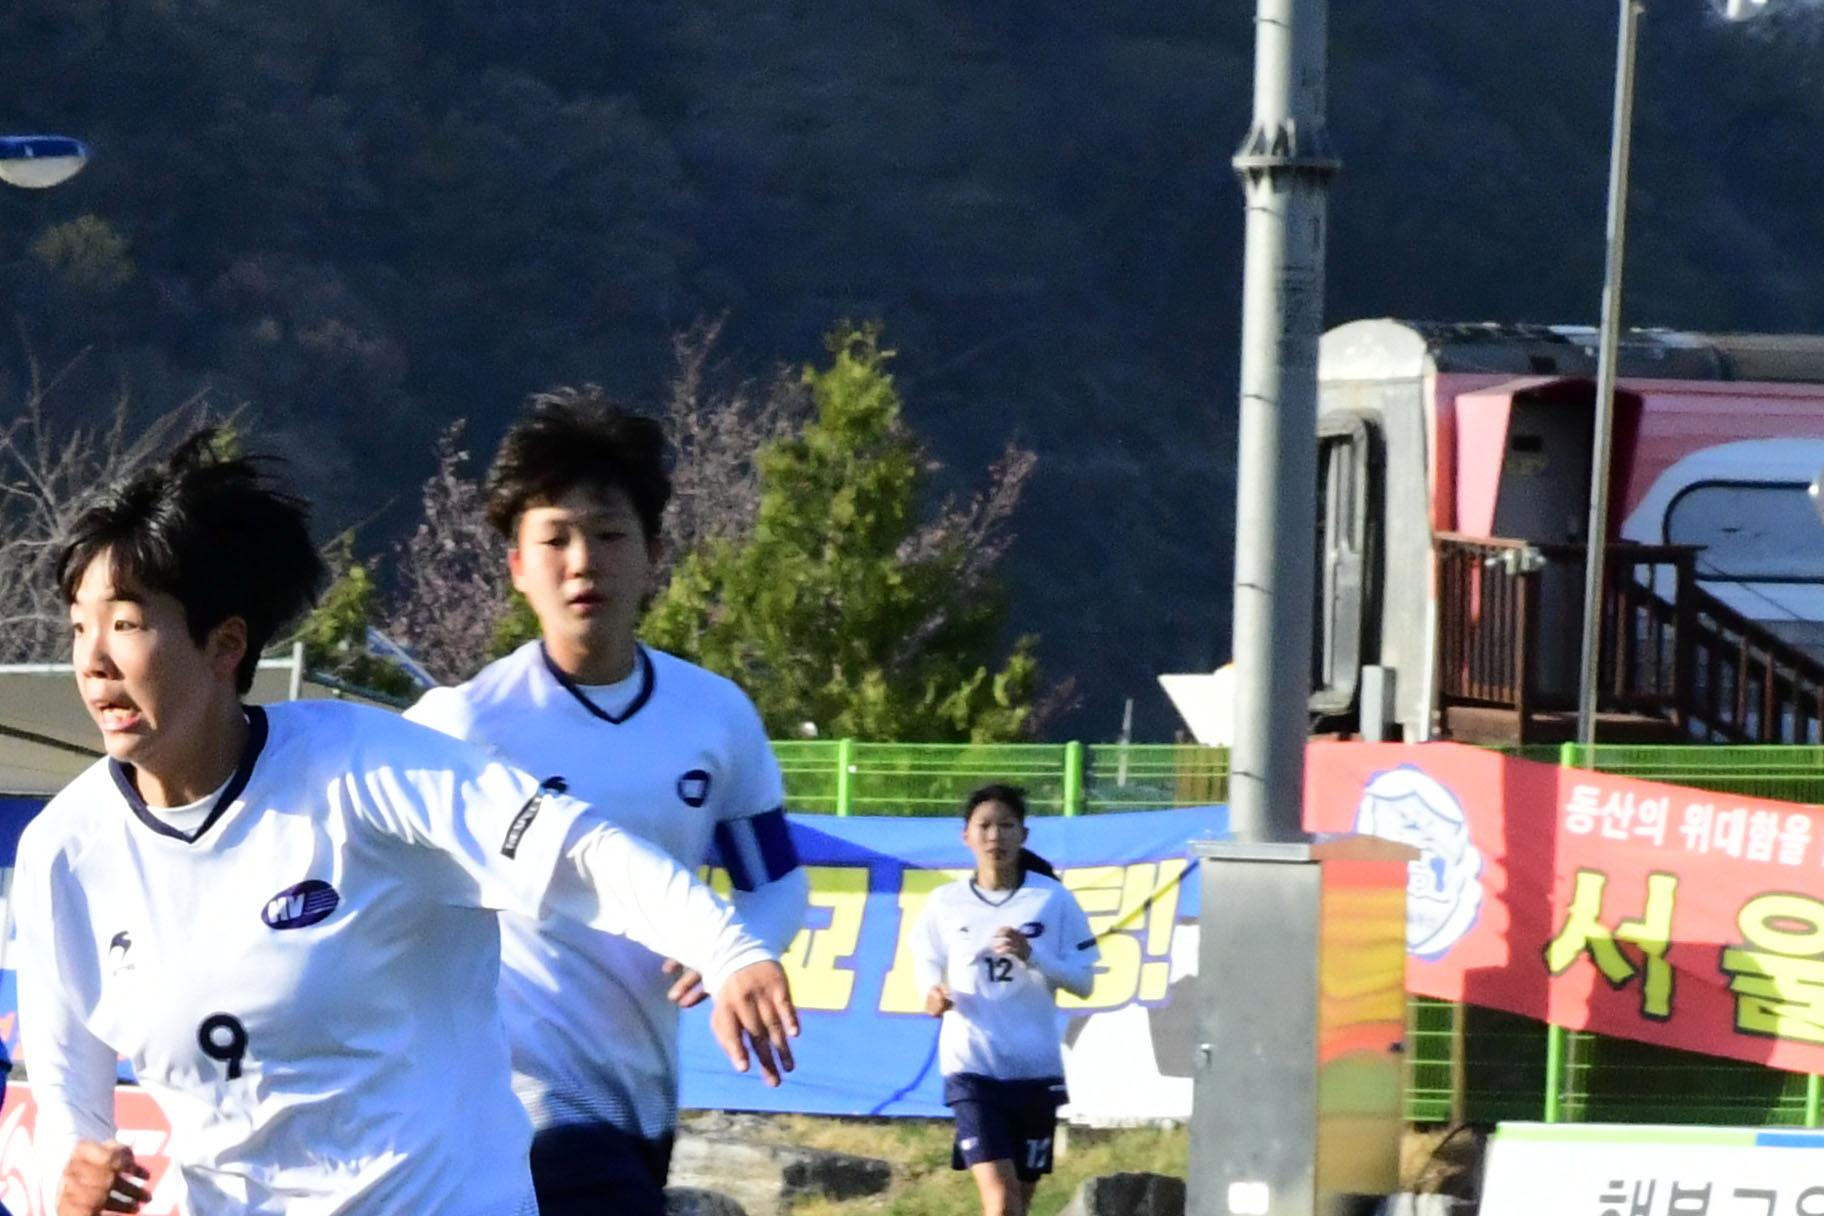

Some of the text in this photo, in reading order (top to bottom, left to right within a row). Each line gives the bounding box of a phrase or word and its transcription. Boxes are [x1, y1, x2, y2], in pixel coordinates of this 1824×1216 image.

[1564, 784, 1812, 866] 동산의 위대함을
[984, 957, 1015, 983] 12
[197, 1012, 249, 1081] 9
